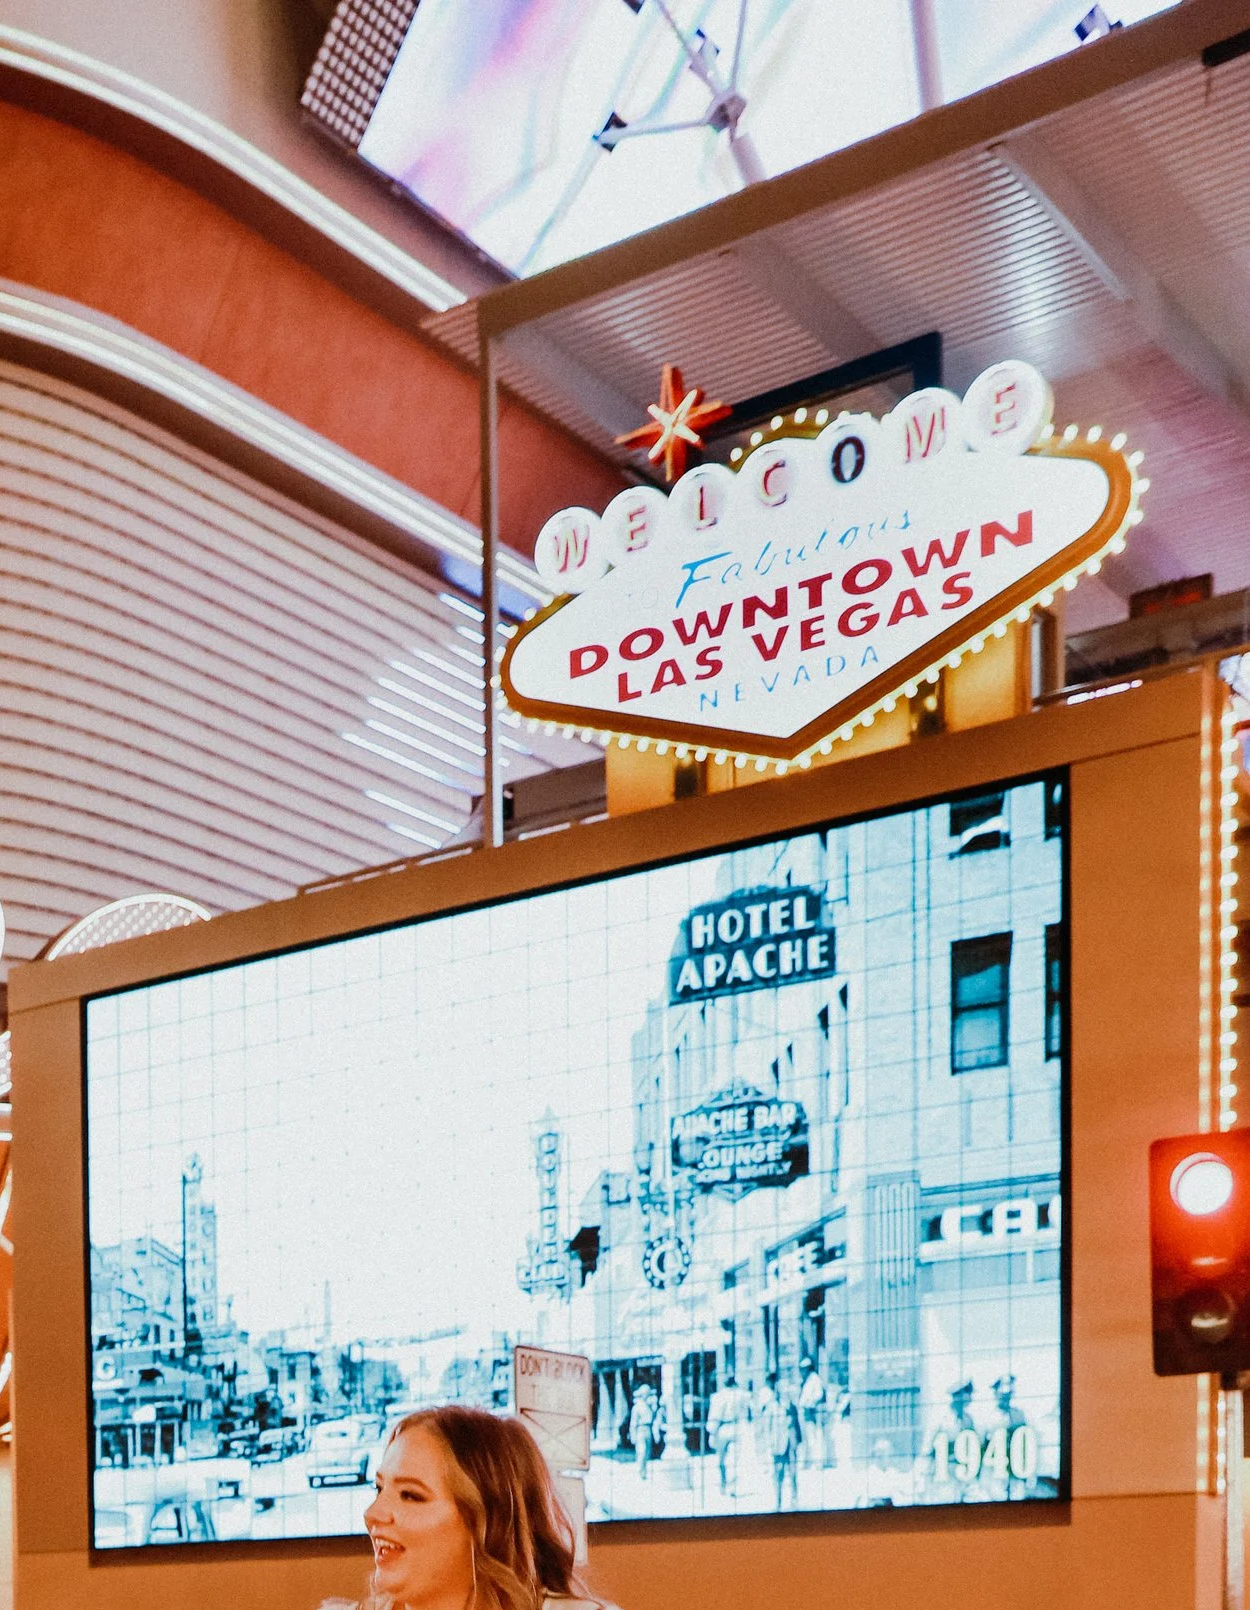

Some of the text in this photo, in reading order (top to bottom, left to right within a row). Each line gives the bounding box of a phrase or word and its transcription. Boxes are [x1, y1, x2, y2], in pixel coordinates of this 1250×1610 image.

[554, 380, 1019, 573] WELCOME
[675, 508, 913, 609] Fabulous
[568, 509, 1035, 680] DOWNTOWN
[617, 571, 974, 703] LAS VEGAS
[698, 645, 881, 712] NEVADA
[691, 896, 815, 949] HOTEL
[676, 934, 829, 992] APACHE
[753, 1102, 797, 1130] BAR
[696, 1141, 784, 1170] OUNGE
[932, 1425, 1037, 1482] 1940
